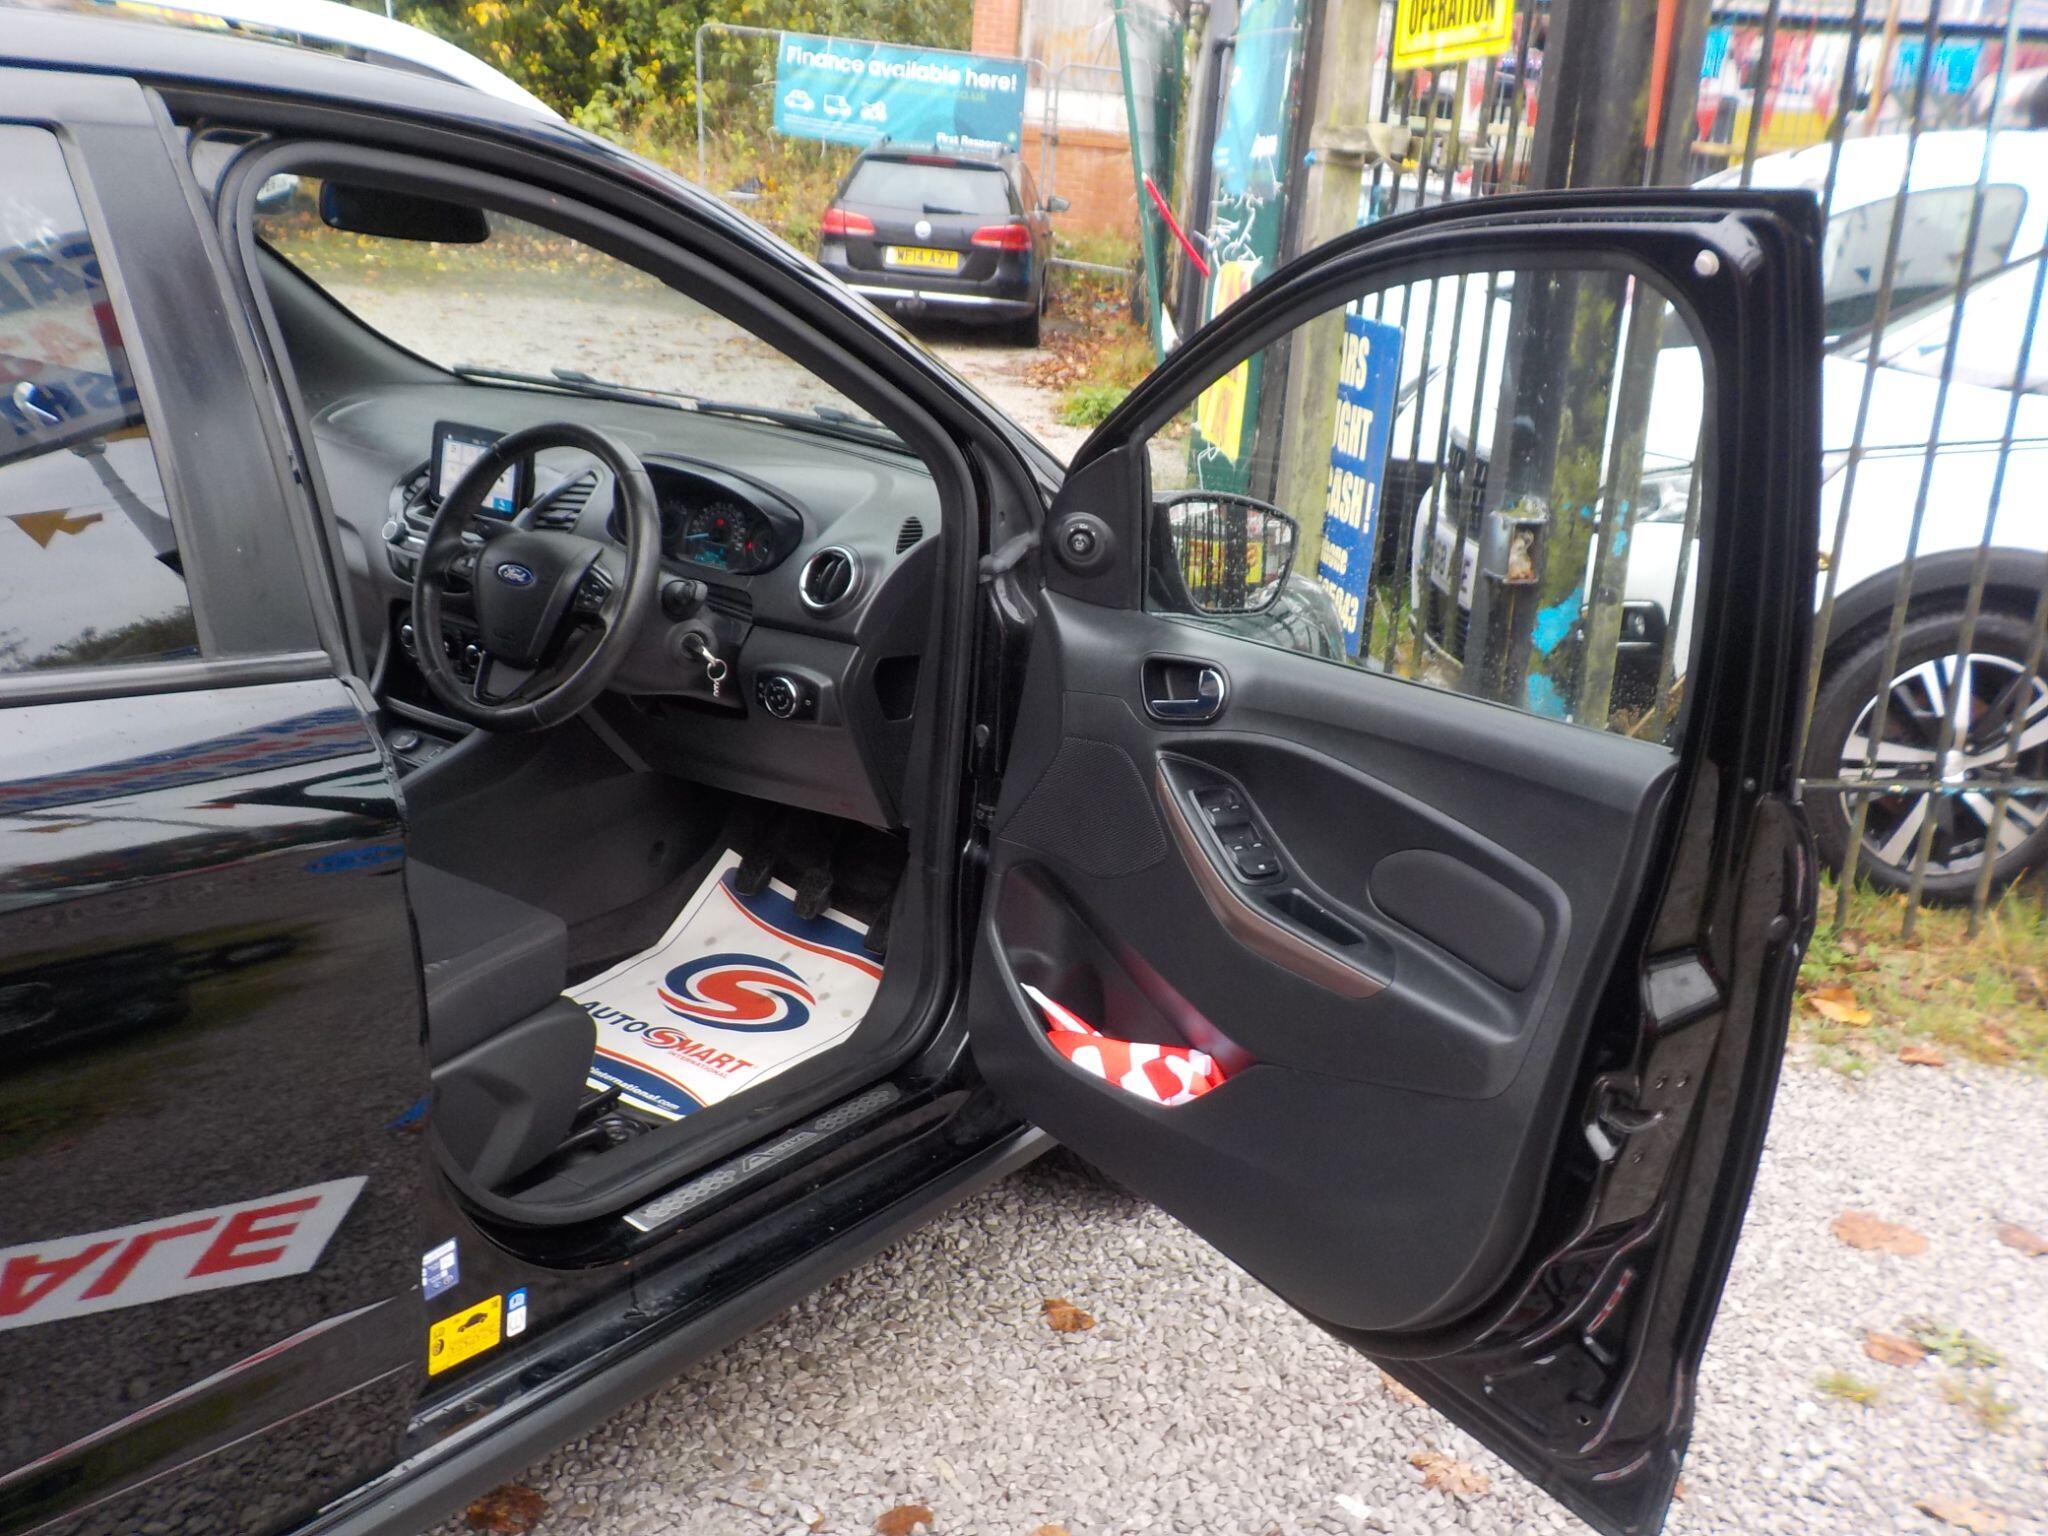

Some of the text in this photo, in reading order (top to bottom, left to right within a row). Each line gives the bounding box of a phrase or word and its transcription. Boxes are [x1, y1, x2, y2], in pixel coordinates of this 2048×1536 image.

[1408, 0, 1496, 35] OPERATION
[786, 45, 865, 74] Finance
[868, 59, 962, 86] available
[965, 67, 1018, 94] here!
